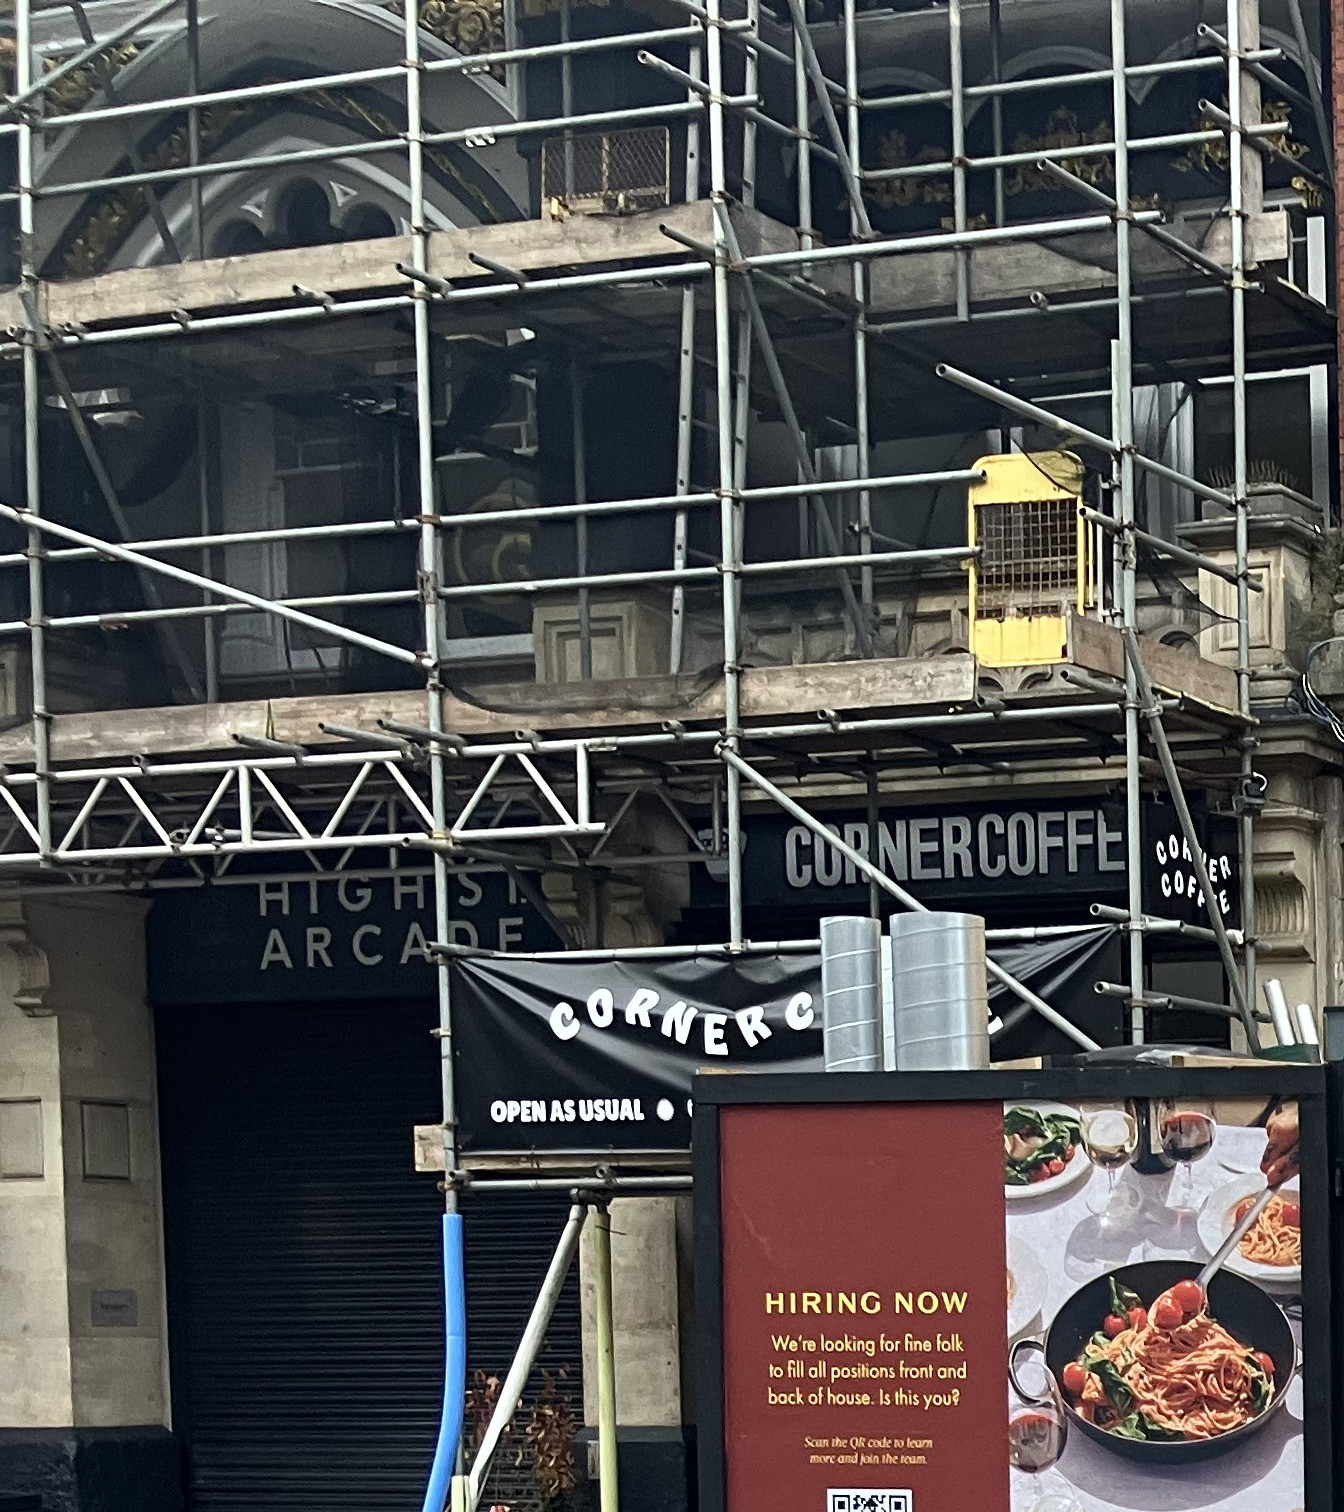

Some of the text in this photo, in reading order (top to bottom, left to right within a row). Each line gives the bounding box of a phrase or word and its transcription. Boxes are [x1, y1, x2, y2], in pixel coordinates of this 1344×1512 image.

[1156, 834, 1231, 883] CORER
[258, 875, 425, 916] HIGH
[259, 916, 525, 970] ARCADE
[549, 988, 772, 1056] CORNER
[490, 1098, 645, 1123] OPEN AS USUAL
[765, 1291, 968, 1314] HIRING NOW
[771, 1333, 965, 1357] We're looking for fine folk
[769, 1359, 968, 1383] to fill all positions front and
[767, 1386, 961, 1411] back of house. Is this you?
[803, 1435, 934, 1450] Scan the QR code to learn
[809, 1453, 836, 1464] more
[837, 1452, 858, 1464] and
[859, 1453, 880, 1466] join
[881, 1453, 898, 1465] the
